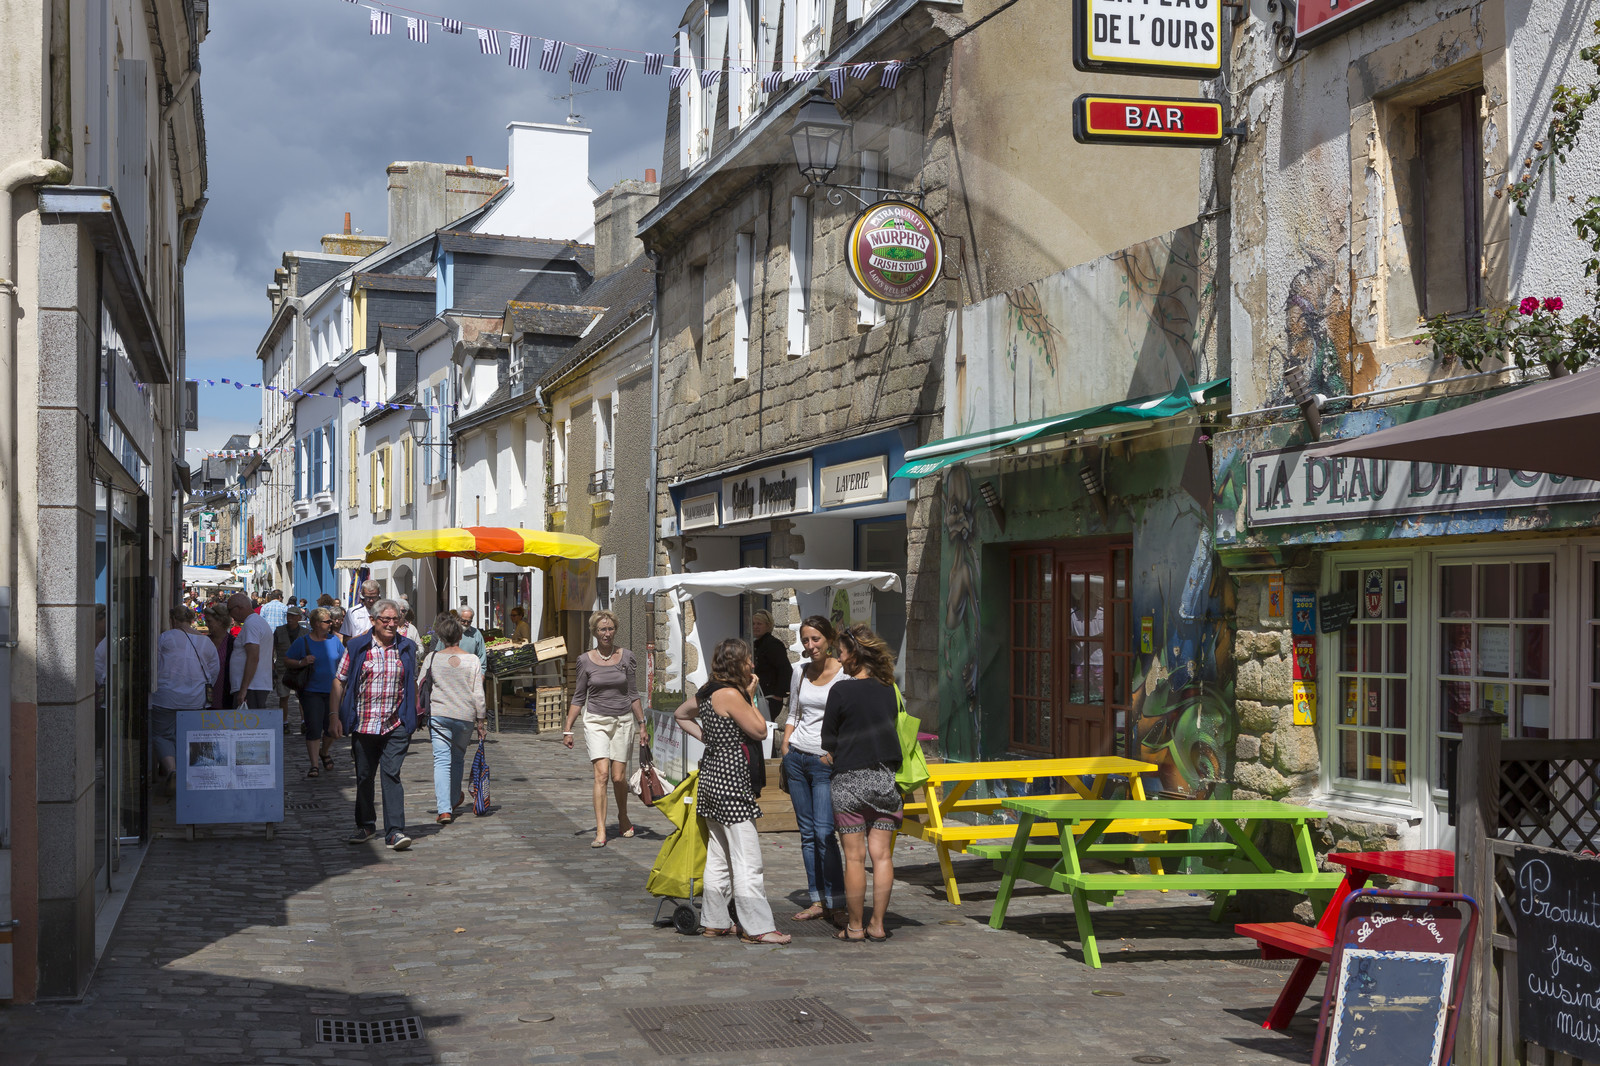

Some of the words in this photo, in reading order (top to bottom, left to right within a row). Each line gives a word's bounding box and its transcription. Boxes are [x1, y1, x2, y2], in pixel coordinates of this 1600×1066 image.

[1094, 13, 1121, 44] DE
[1128, 14, 1214, 51] L'OURS
[1125, 106, 1183, 130] BAR
[869, 208, 893, 227] EXTRA
[894, 207, 926, 231] QUALITY
[870, 230, 927, 250] MURPHY'S
[873, 257, 897, 271] IRISH
[899, 260, 924, 271] STOUT
[884, 285, 899, 294] WELL
[900, 274, 925, 294] BREWERY
[759, 470, 797, 512] Pressing
[836, 471, 870, 493] LAVERIE
[1256, 460, 1293, 512] LA
[1303, 456, 1388, 506] PEAU
[1217, 514, 1224, 525] 16
[200, 711, 260, 729] EXPO
[1357, 922, 1374, 943] La
[1371, 911, 1397, 928] Peau
[1402, 910, 1413, 921] de
[1546, 935, 1592, 976] frais
